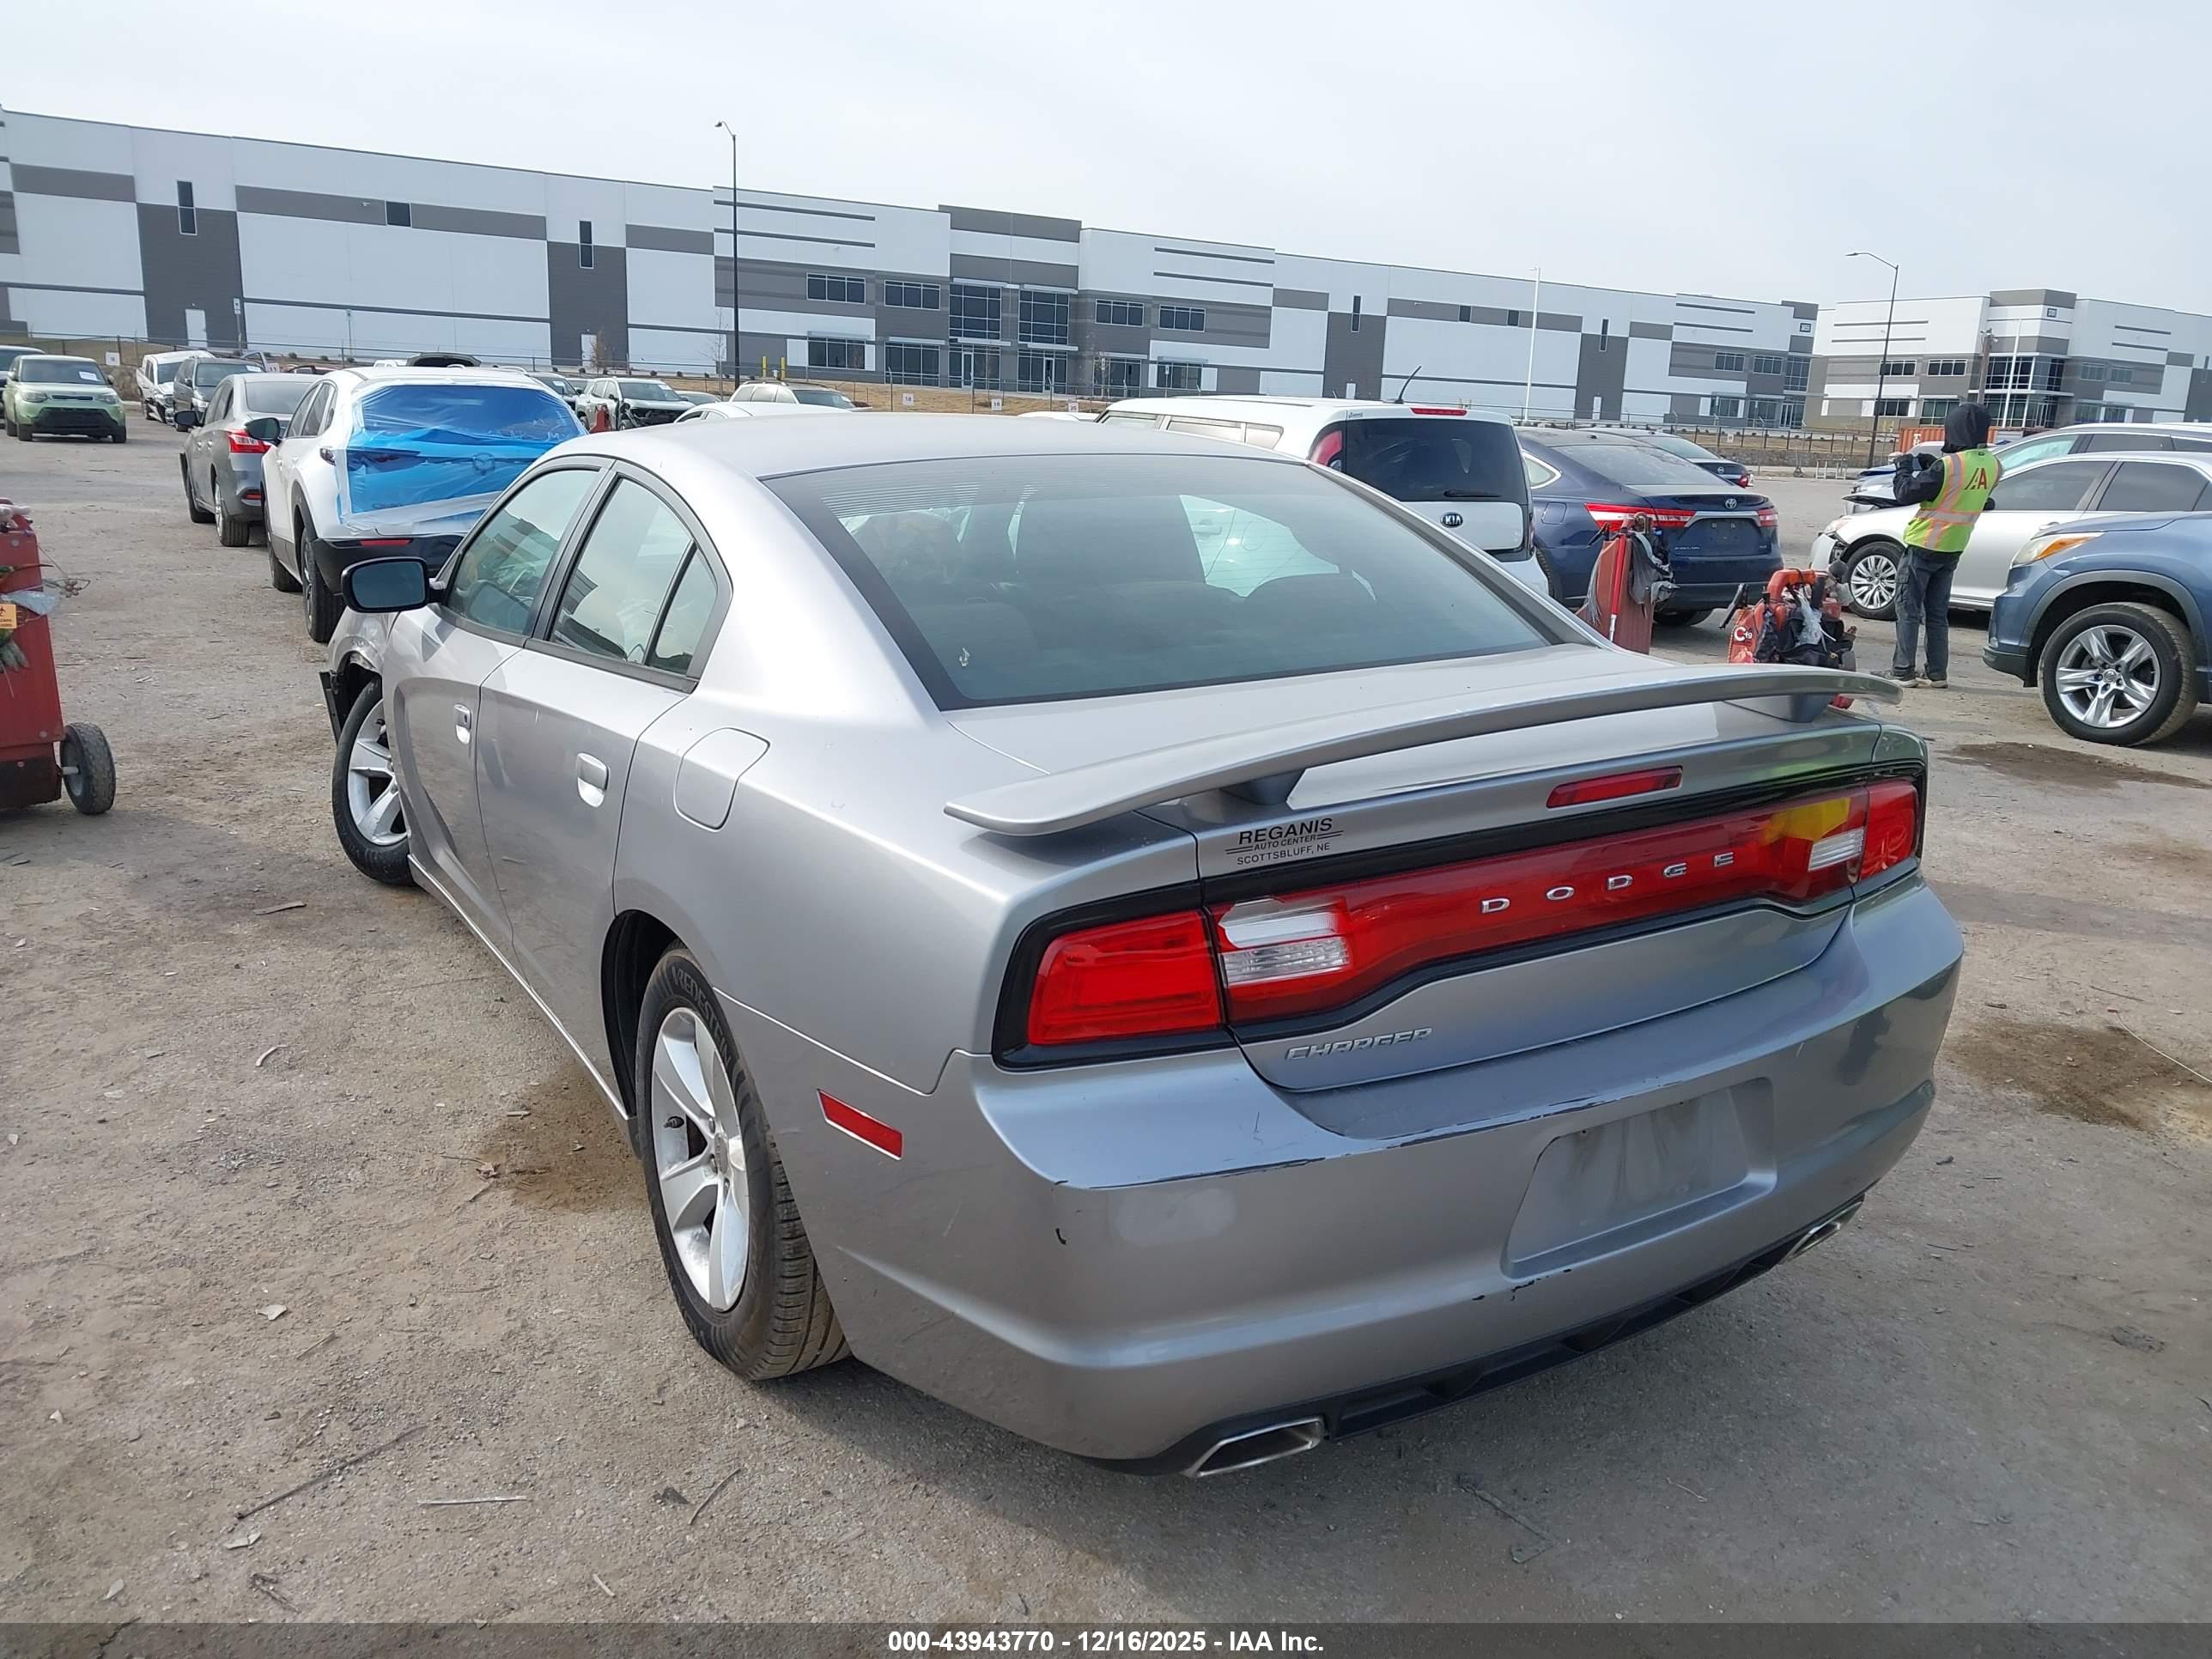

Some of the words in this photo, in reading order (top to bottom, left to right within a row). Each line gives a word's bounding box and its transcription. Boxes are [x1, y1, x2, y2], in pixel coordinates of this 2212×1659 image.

[1445, 514, 1462, 526] KIA
[1238, 817, 1334, 845] REGANIS
[1254, 839, 1279, 851] AUTO
[1280, 834, 1317, 848] CENTER
[1237, 846, 1315, 866] SCOTTSBLUFF,
[1316, 842, 1330, 852] NE
[1480, 851, 1735, 915] DODGE
[1285, 1027, 1433, 1060] CHARGER
